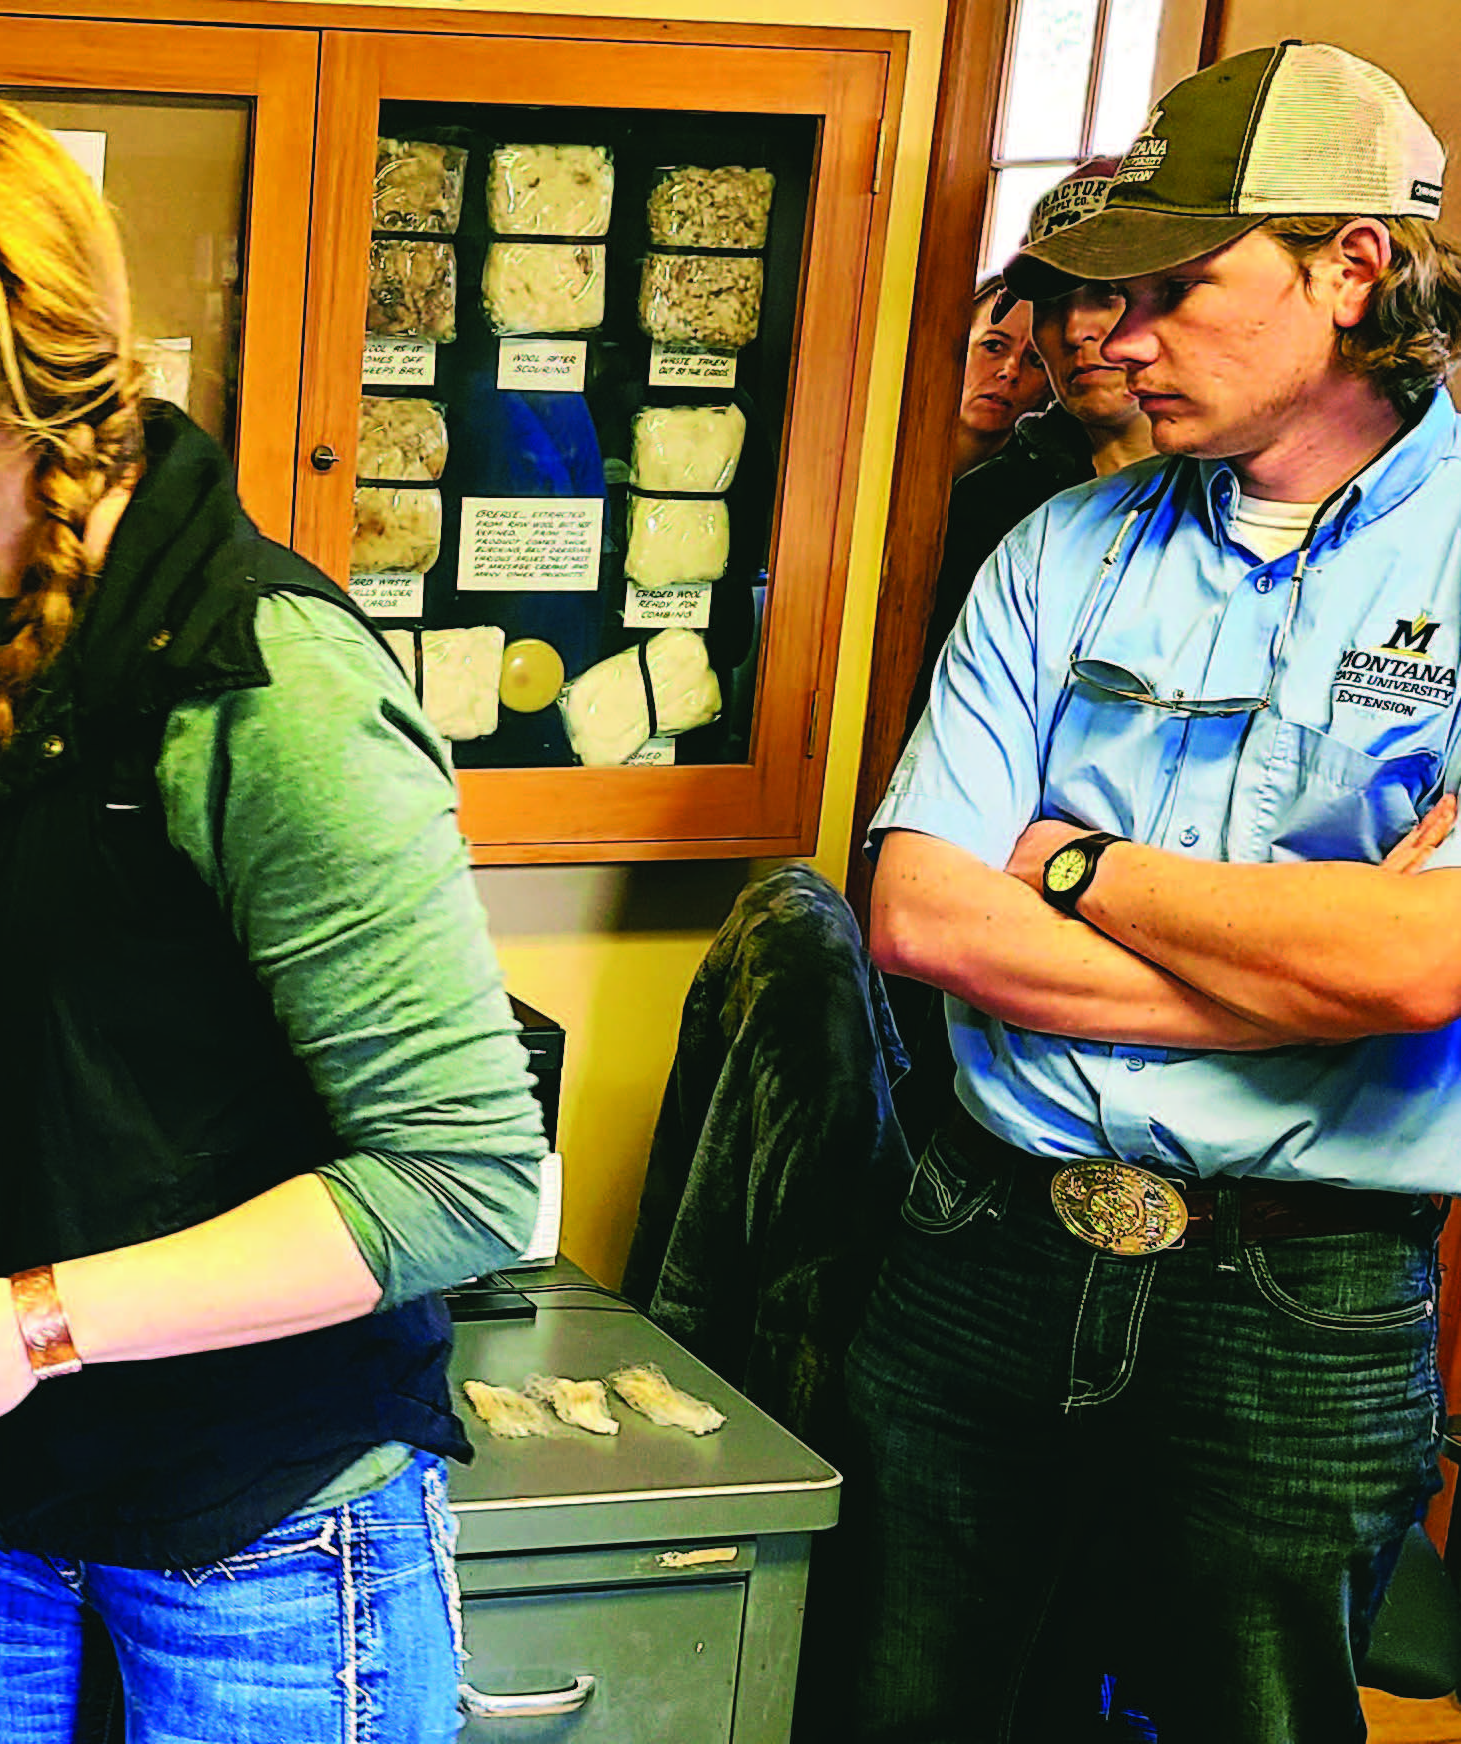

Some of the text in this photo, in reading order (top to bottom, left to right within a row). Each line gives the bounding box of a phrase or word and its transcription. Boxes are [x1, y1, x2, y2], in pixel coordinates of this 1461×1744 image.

[511, 353, 577, 365] WOOL AFTER
[660, 357, 729, 367] WASTE TAKEN
[398, 367, 425, 376] BACK
[513, 364, 571, 374] SCOURING
[378, 578, 412, 587] WASTE
[380, 589, 413, 598] UNDER
[635, 589, 701, 599] CARDED WOOL
[638, 600, 699, 609] READY FOR
[640, 610, 693, 619] COMBING
[1338, 649, 1457, 689] MONTANA
[1366, 674, 1454, 702] UNIVERSITY
[1335, 689, 1417, 717] EXTENSION
